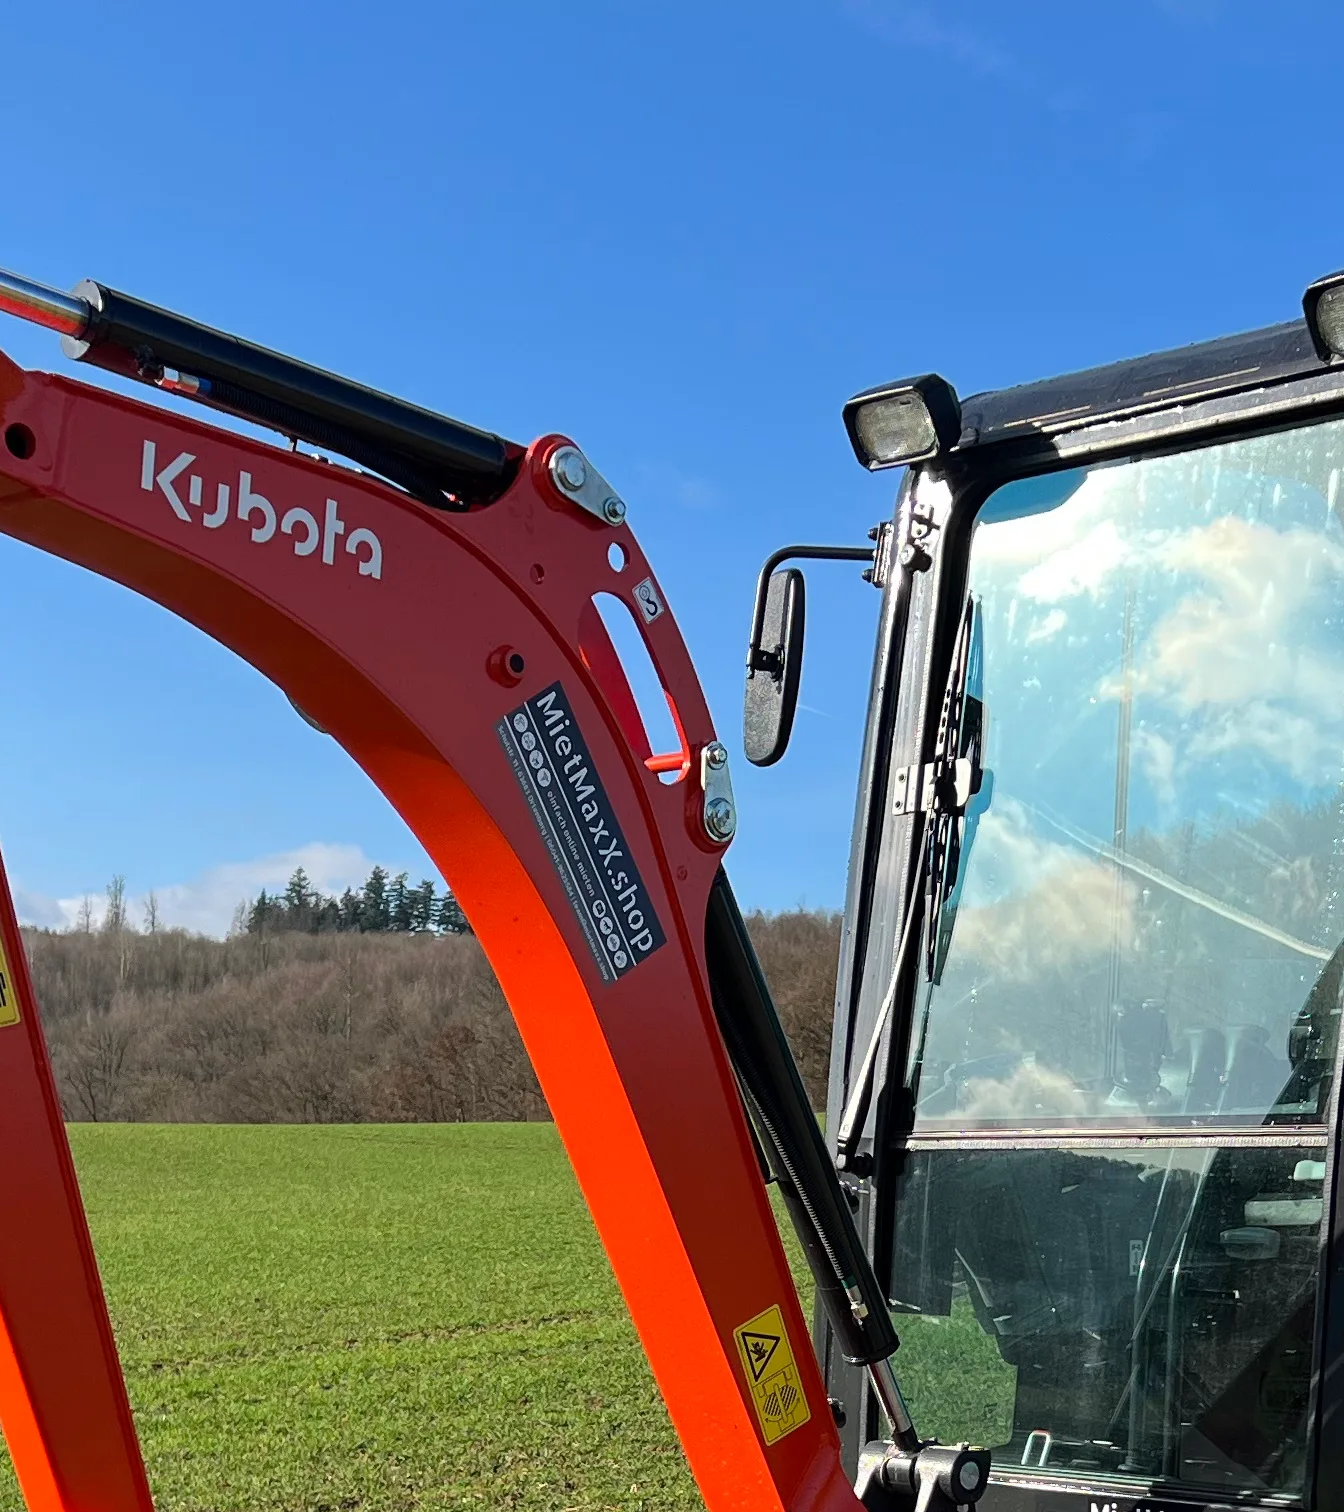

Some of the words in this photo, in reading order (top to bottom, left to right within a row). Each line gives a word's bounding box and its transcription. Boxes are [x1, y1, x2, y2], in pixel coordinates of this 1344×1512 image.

[141, 440, 382, 579] Kubota
[536, 690, 654, 951] MietMaxX.shop
[547, 790, 566, 829] einfach
[563, 830, 579, 861] online
[577, 862, 595, 897] mieten
